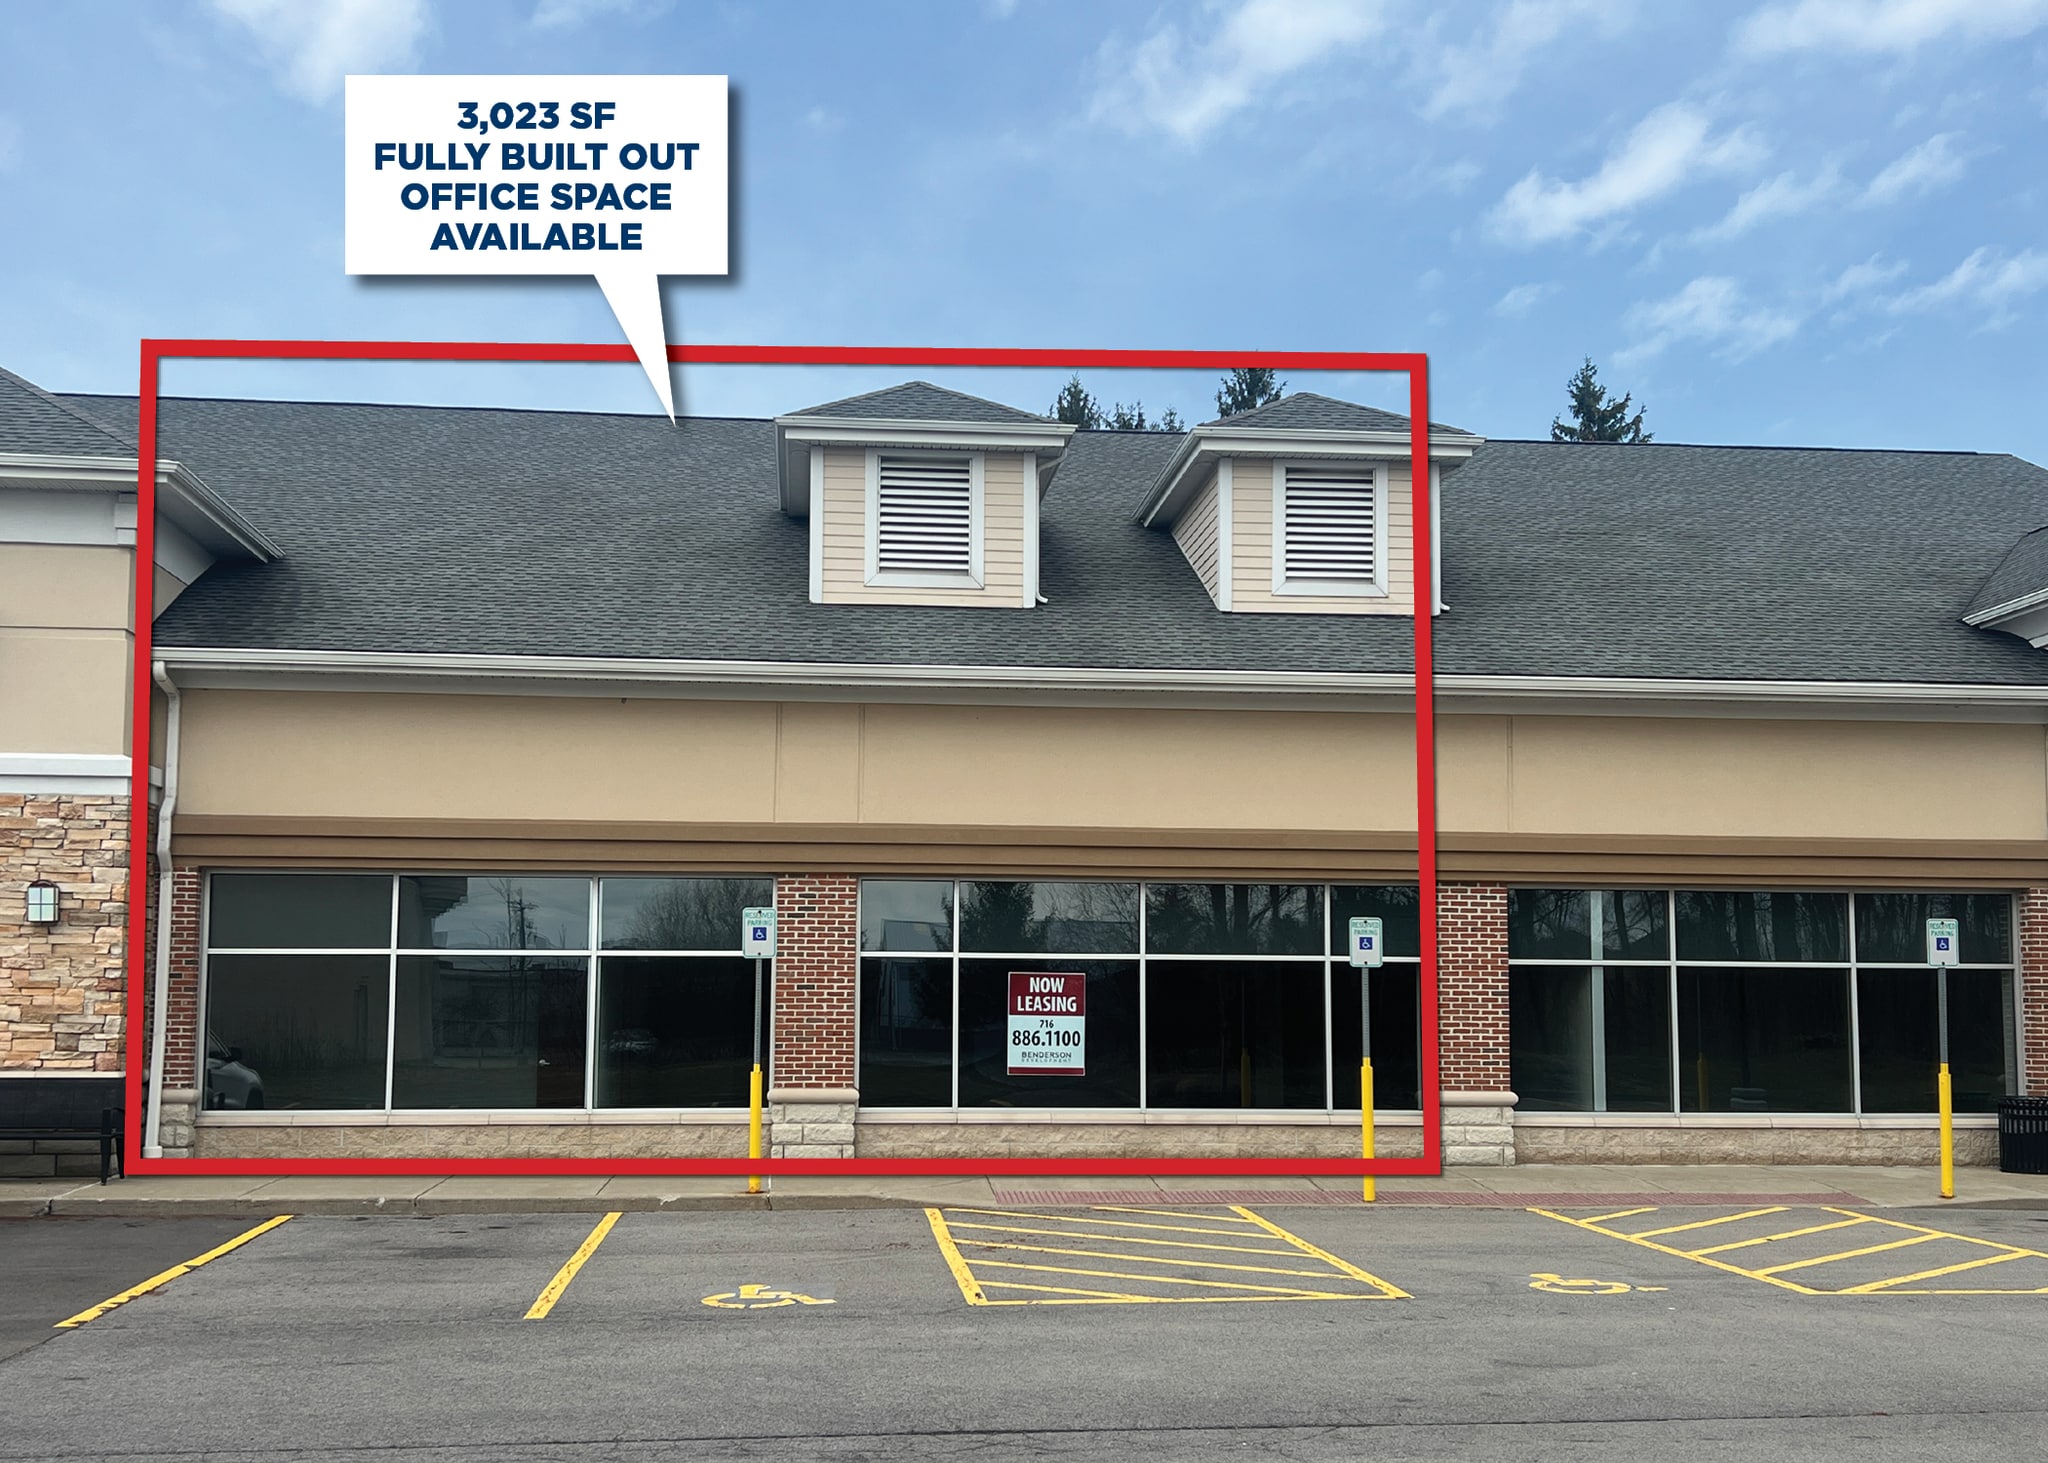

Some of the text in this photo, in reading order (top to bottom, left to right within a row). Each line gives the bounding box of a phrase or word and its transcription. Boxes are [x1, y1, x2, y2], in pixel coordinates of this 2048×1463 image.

[1029, 976, 1065, 993] NOW
[1017, 995, 1077, 1013] LEASING
[1039, 1019, 1055, 1029] 716
[1012, 1029, 1081, 1047] 886.1100
[1021, 1051, 1072, 1059] BENDERSON
